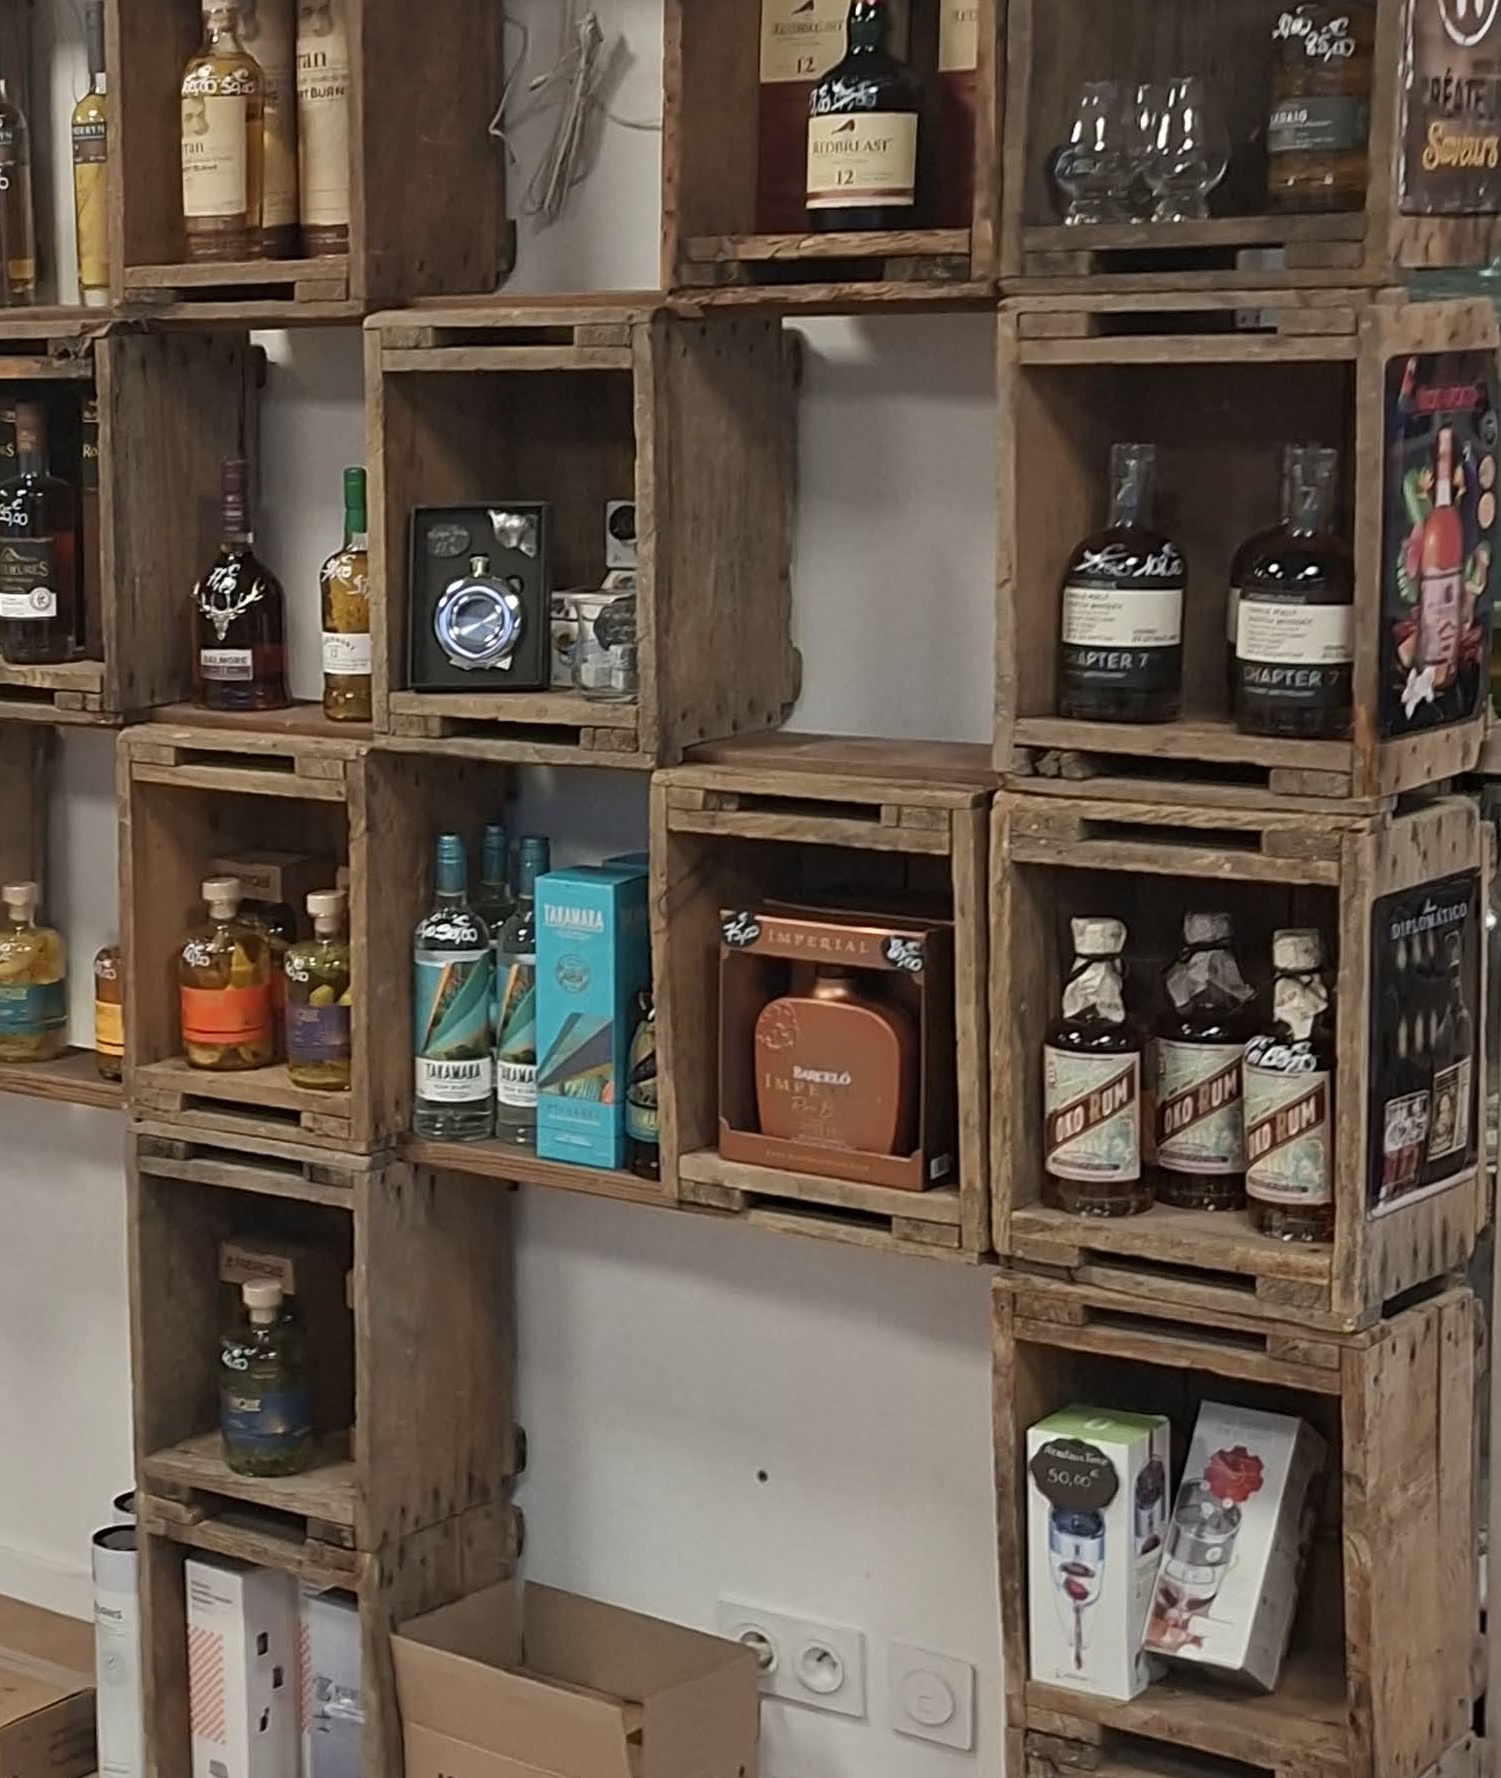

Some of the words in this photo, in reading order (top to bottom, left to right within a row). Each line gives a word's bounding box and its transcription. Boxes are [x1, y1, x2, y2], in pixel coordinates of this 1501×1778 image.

[796, 56, 817, 74] 12
[812, 137, 893, 154] REDBREAST
[835, 169, 855, 186] 12
[1138, 651, 1150, 669] 7
[1243, 666, 1322, 688] CHAPTER
[543, 903, 603, 928] TAKAMAKA
[769, 930, 870, 955] IMPERIAL
[425, 1062, 482, 1080] TAKAMAKA
[793, 1065, 851, 1086] BARCELÓ
[1088, 1077, 1130, 1126] RUM
[1196, 1066, 1239, 1119] RUM
[1274, 1096, 1317, 1147] RUM
